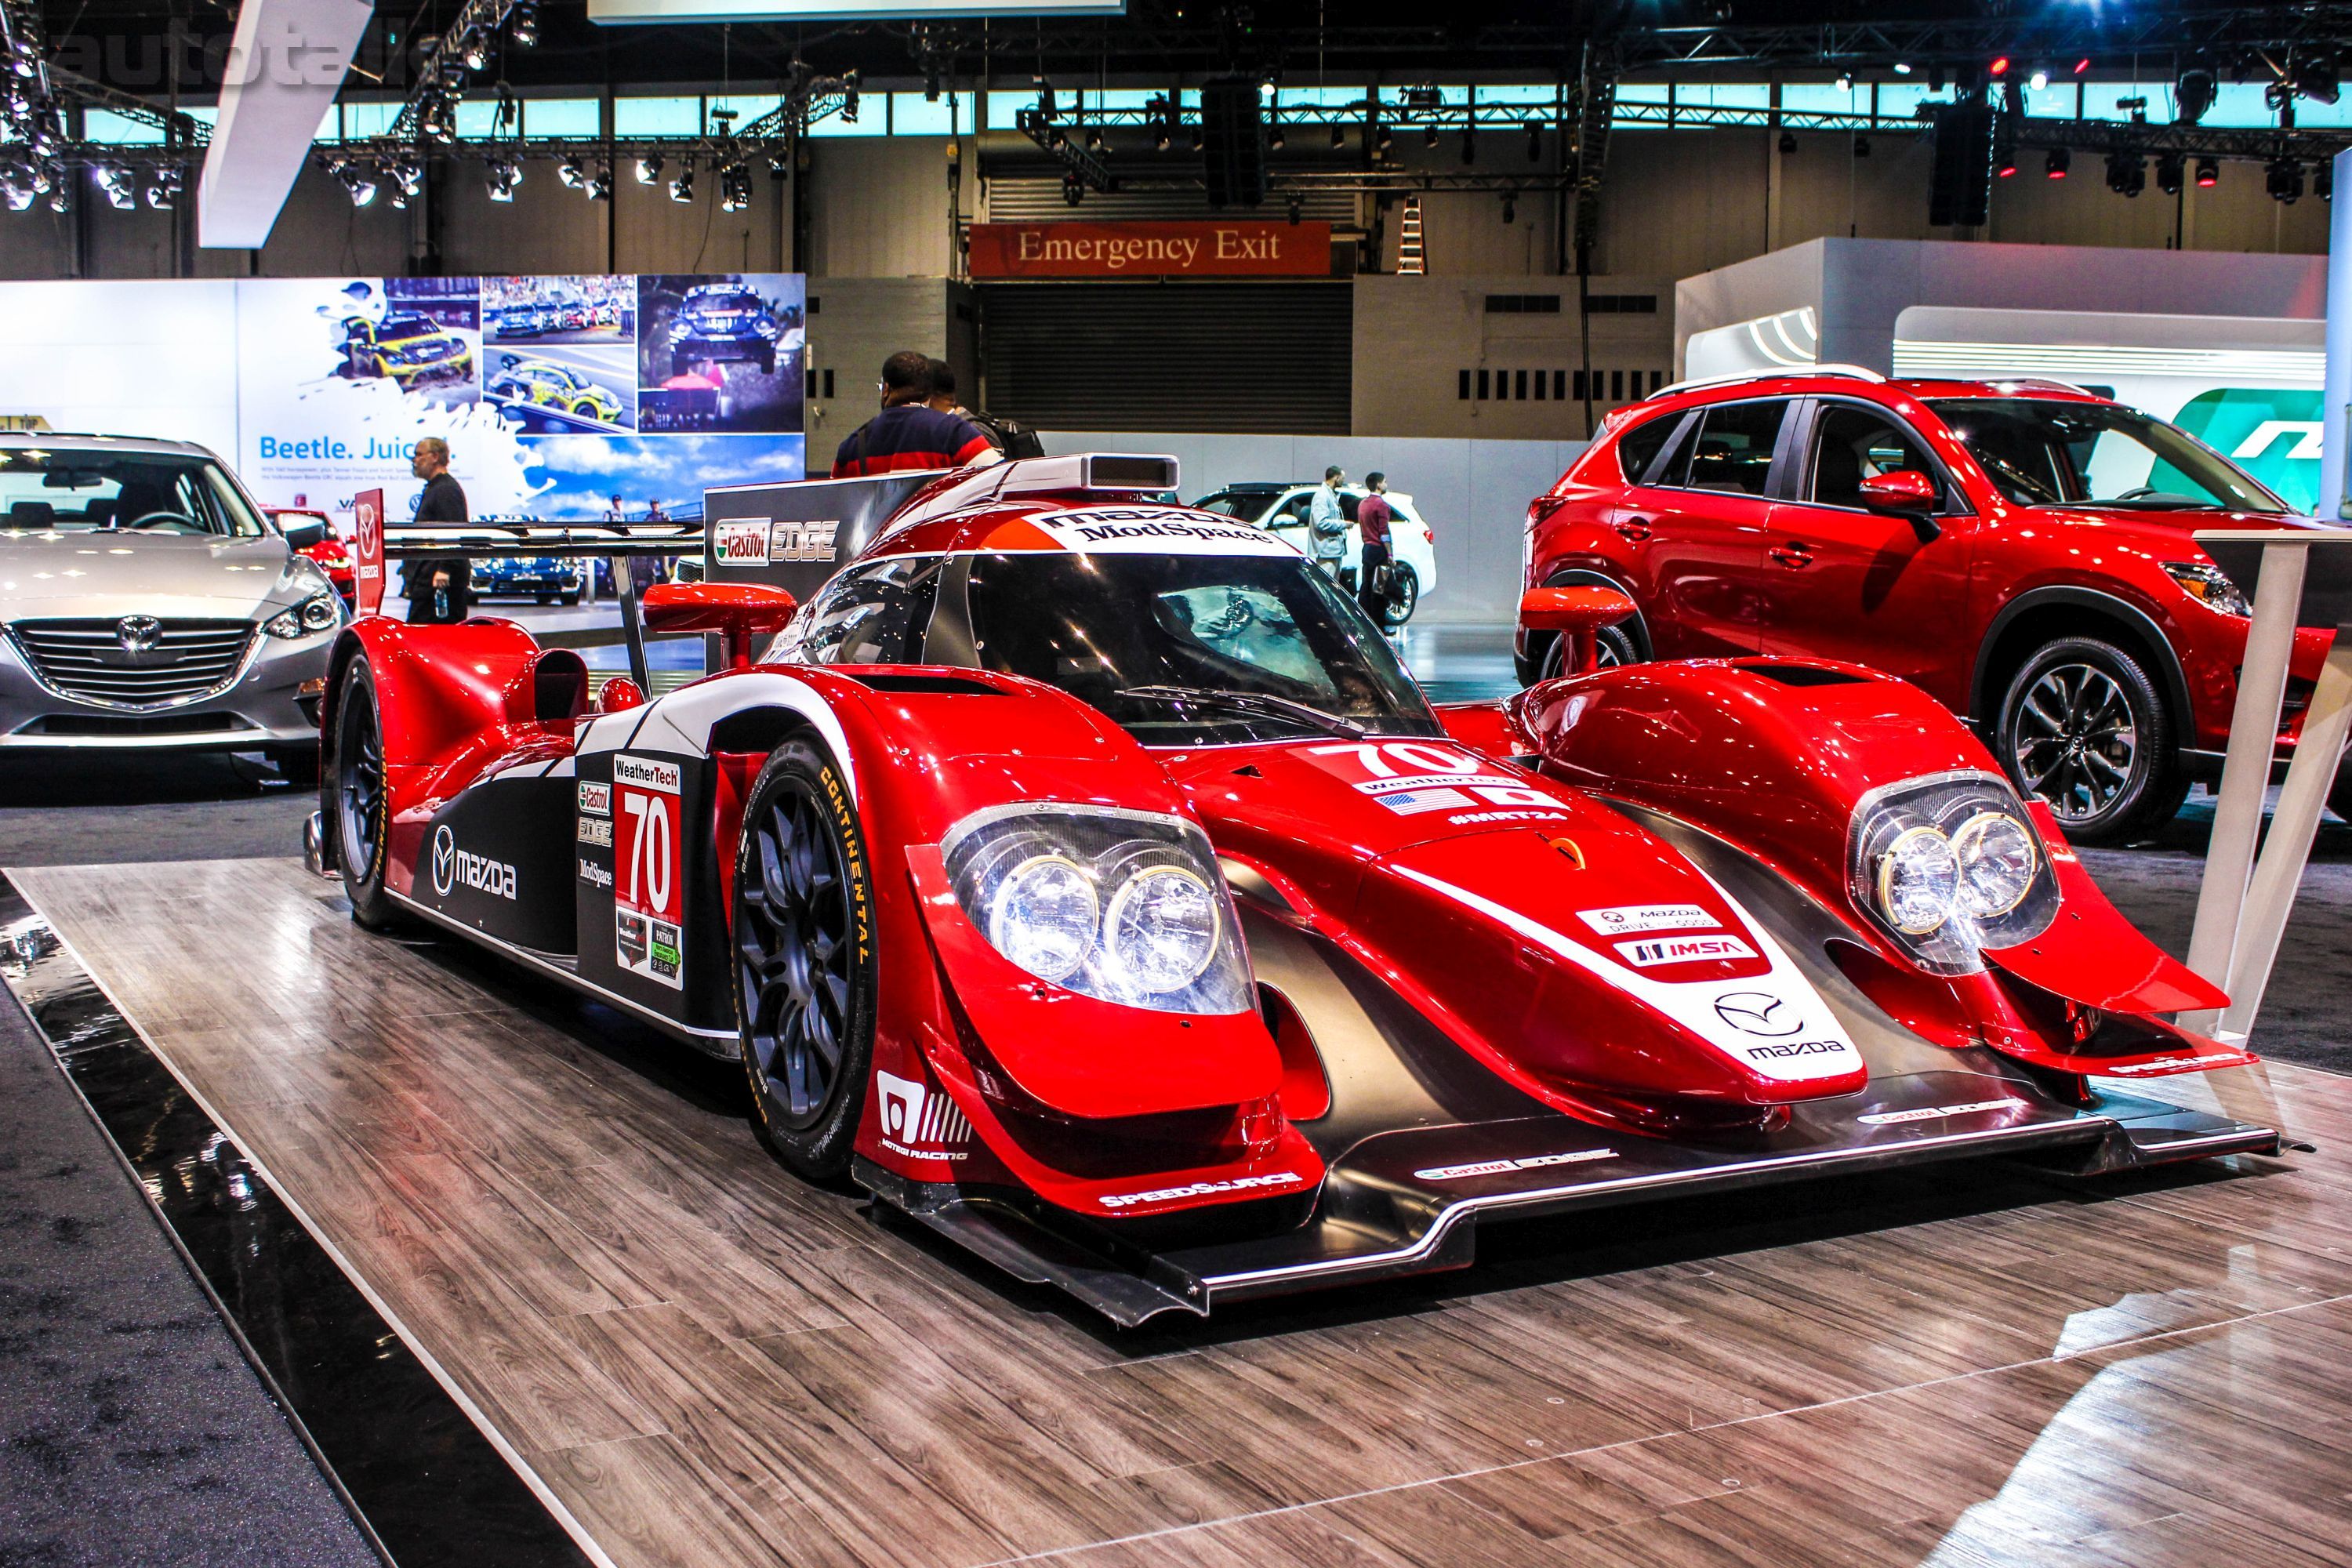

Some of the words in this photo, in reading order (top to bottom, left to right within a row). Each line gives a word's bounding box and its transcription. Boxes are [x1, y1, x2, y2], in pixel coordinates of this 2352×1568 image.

[1018, 231, 1200, 269] Emergency
[1216, 230, 1281, 260] Exit
[260, 437, 353, 459] Beetle.
[363, 436, 456, 459] Juic.
[728, 527, 766, 558] Castrol
[770, 521, 840, 562] EDGE
[1075, 523, 1274, 544] ModSpace
[615, 760, 678, 787] WeatherTech
[1307, 743, 1480, 779] 70
[586, 787, 608, 810] Castrol
[1448, 811, 1568, 826] #MRT24
[577, 816, 613, 848] EDGE
[624, 791, 671, 913] 70
[579, 858, 612, 888] ModSpace
[820, 766, 869, 965] CONTINENTAL
[1610, 922, 1656, 932] DRIVE
[1670, 942, 1744, 956] IMSA
[882, 1138, 909, 1156] MOTEGI
[1442, 1163, 1508, 1177] Castrol
